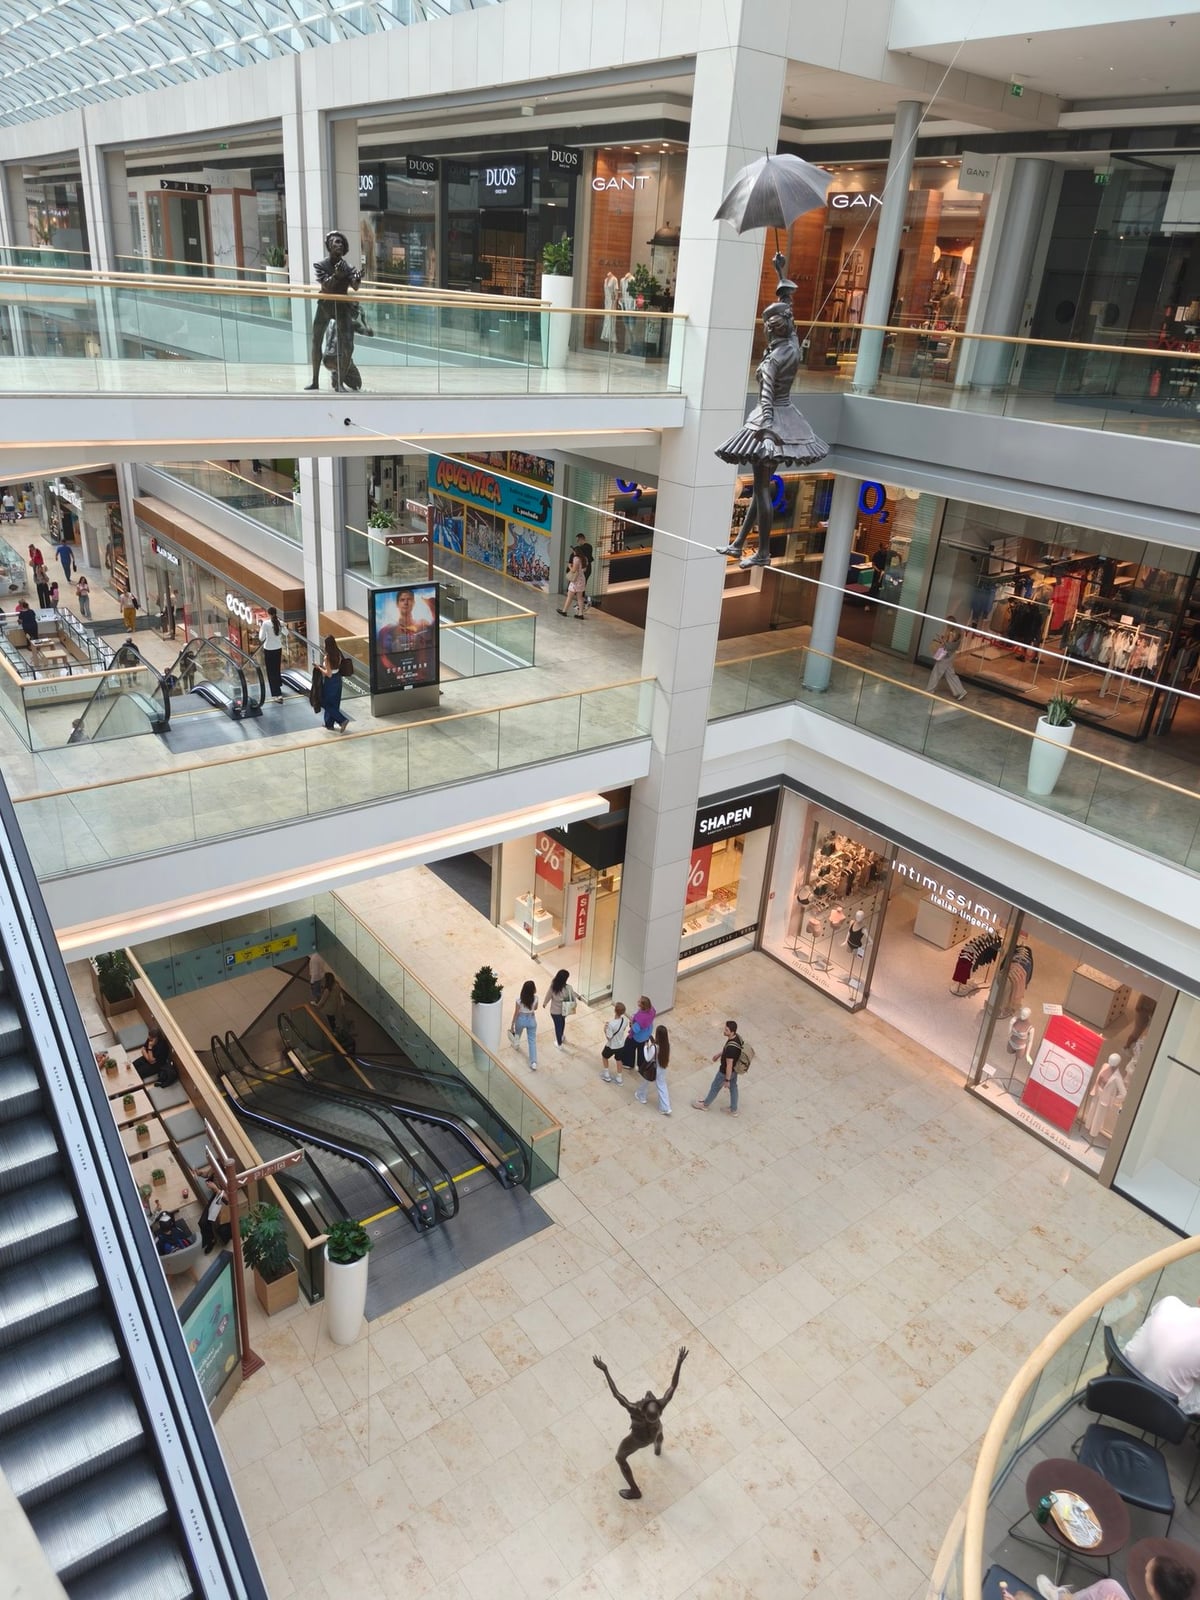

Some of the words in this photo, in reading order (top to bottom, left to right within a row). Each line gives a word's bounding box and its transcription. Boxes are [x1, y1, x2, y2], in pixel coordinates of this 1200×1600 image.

[409, 160, 434, 172] DUOS
[551, 150, 578, 165] DUOS
[486, 168, 516, 186] DUOS
[592, 175, 649, 191] GANT
[967, 167, 990, 177] GANT
[832, 194, 883, 208] GAN
[436, 459, 502, 505] ADVENTICA
[226, 593, 253, 625] ecco
[387, 662, 427, 674] SUPERMAN
[699, 805, 752, 833] SHAPEN
[892, 860, 997, 923] intimissimi
[578, 898, 587, 936] SALE
[930, 893, 958, 914] italian
[959, 909, 994, 934] lingerie
[226, 955, 234, 965] P
[1039, 1049, 1085, 1095] 50
[159, 1411, 172, 1444] NEHERA
[189, 1508, 203, 1542] NEHERA
